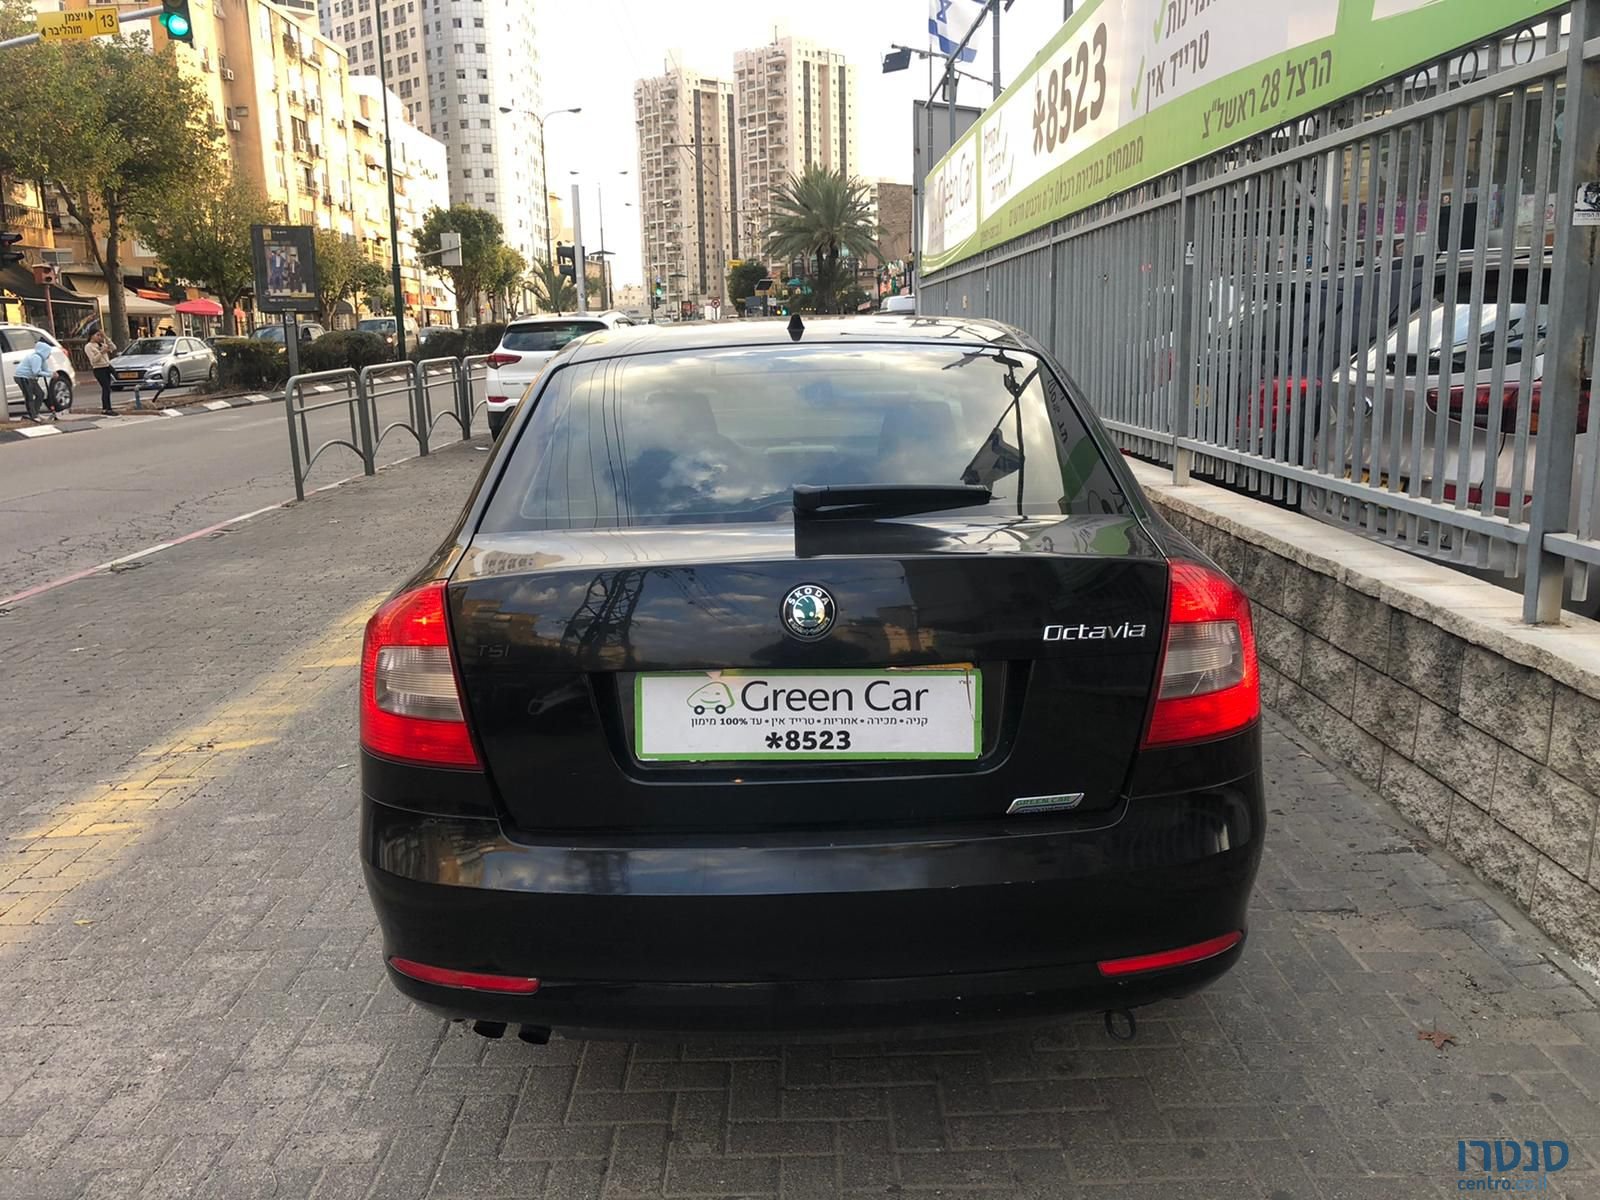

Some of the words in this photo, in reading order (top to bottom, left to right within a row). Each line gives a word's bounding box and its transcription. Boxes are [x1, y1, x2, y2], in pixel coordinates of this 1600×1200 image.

[64, 12, 87, 25] ויצמן
[100, 14, 115, 28] 13
[1169, 30, 1209, 87] טרייד
[1286, 49, 1332, 101] הרצל
[1146, 61, 1166, 114] אין
[1260, 68, 1281, 113] 28
[1106, 135, 1144, 180] מתמחים
[1042, 622, 1147, 641] Octavia
[479, 643, 511, 658] TSI
[741, 680, 853, 712] Green
[864, 680, 929, 712] Car
[691, 717, 717, 728] מימון
[720, 717, 748, 726] 100%
[748, 717, 763, 726] עד
[771, 717, 786, 728] אין
[788, 717, 815, 726] טרייד
[823, 717, 859, 726] אחריות
[866, 717, 898, 726] מכירה
[905, 717, 929, 727] קניה
